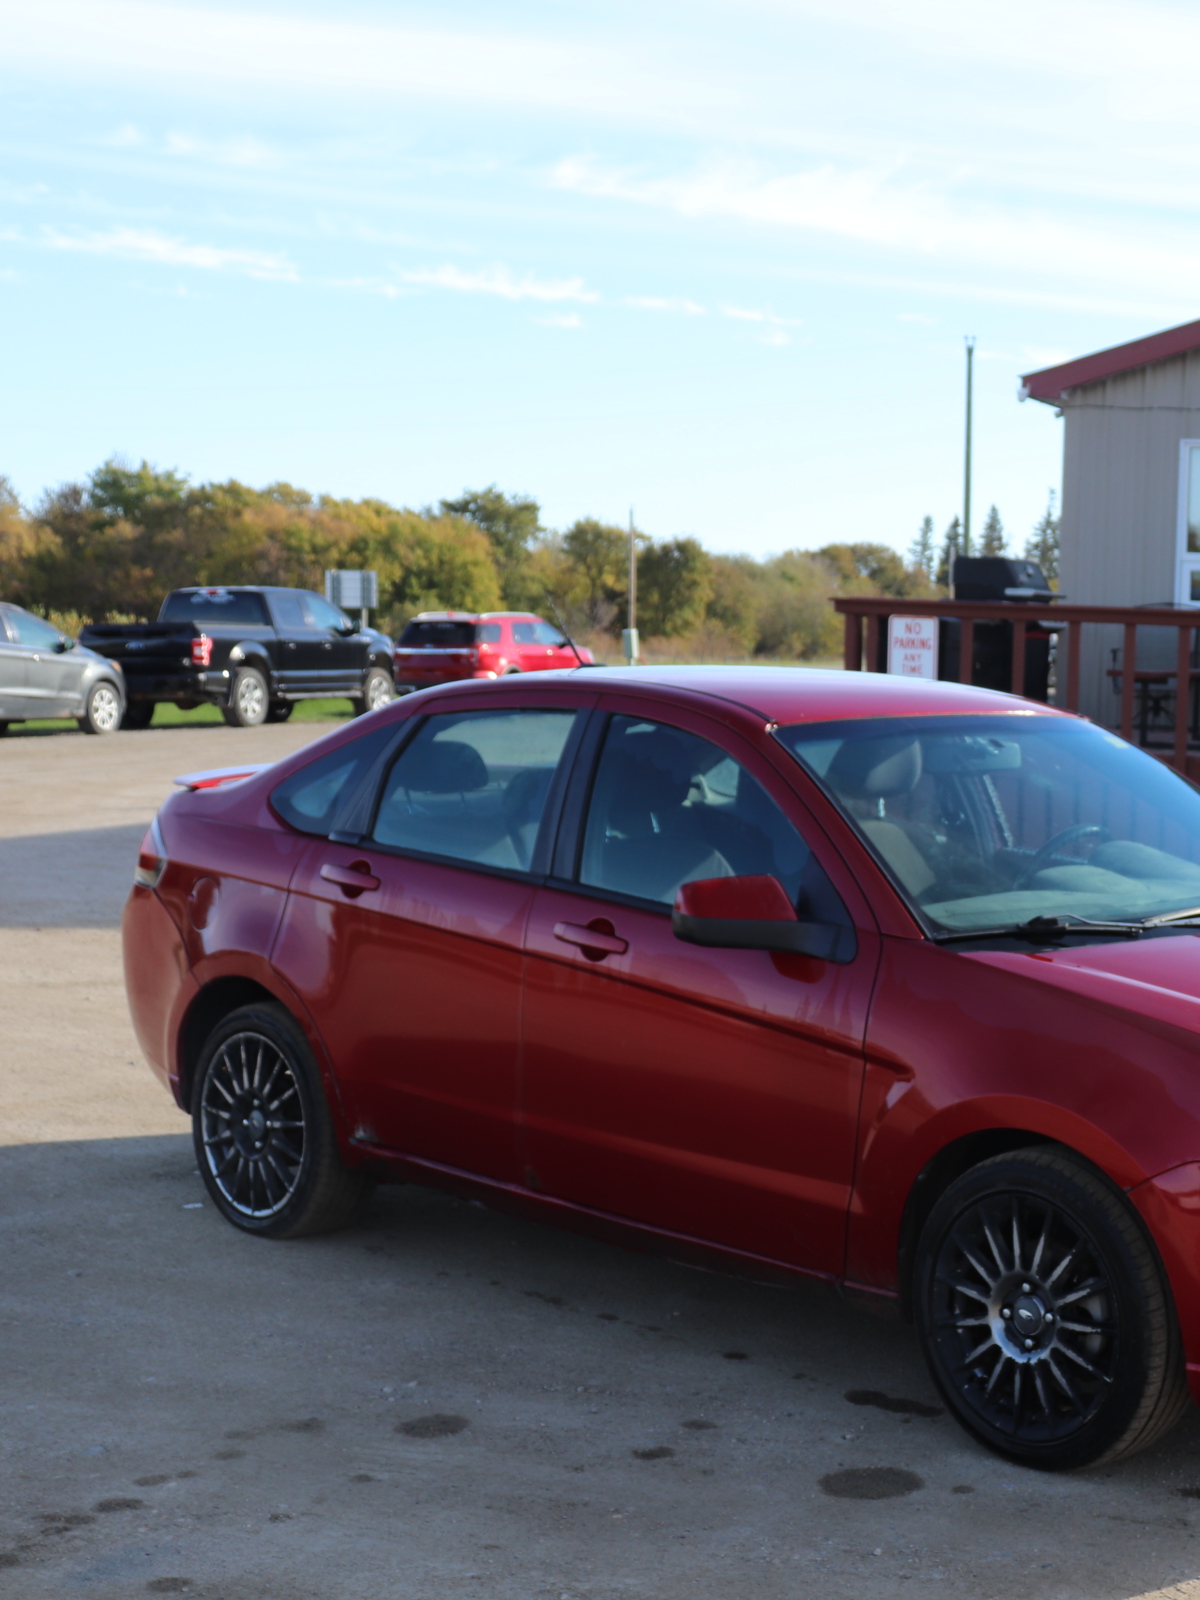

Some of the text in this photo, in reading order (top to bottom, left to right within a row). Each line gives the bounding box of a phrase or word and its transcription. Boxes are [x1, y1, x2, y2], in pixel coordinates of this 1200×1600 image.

[904, 621, 922, 635] NO
[893, 636, 932, 650] PARKING
[903, 652, 922, 662] ANY
[902, 663, 923, 675] TIME
